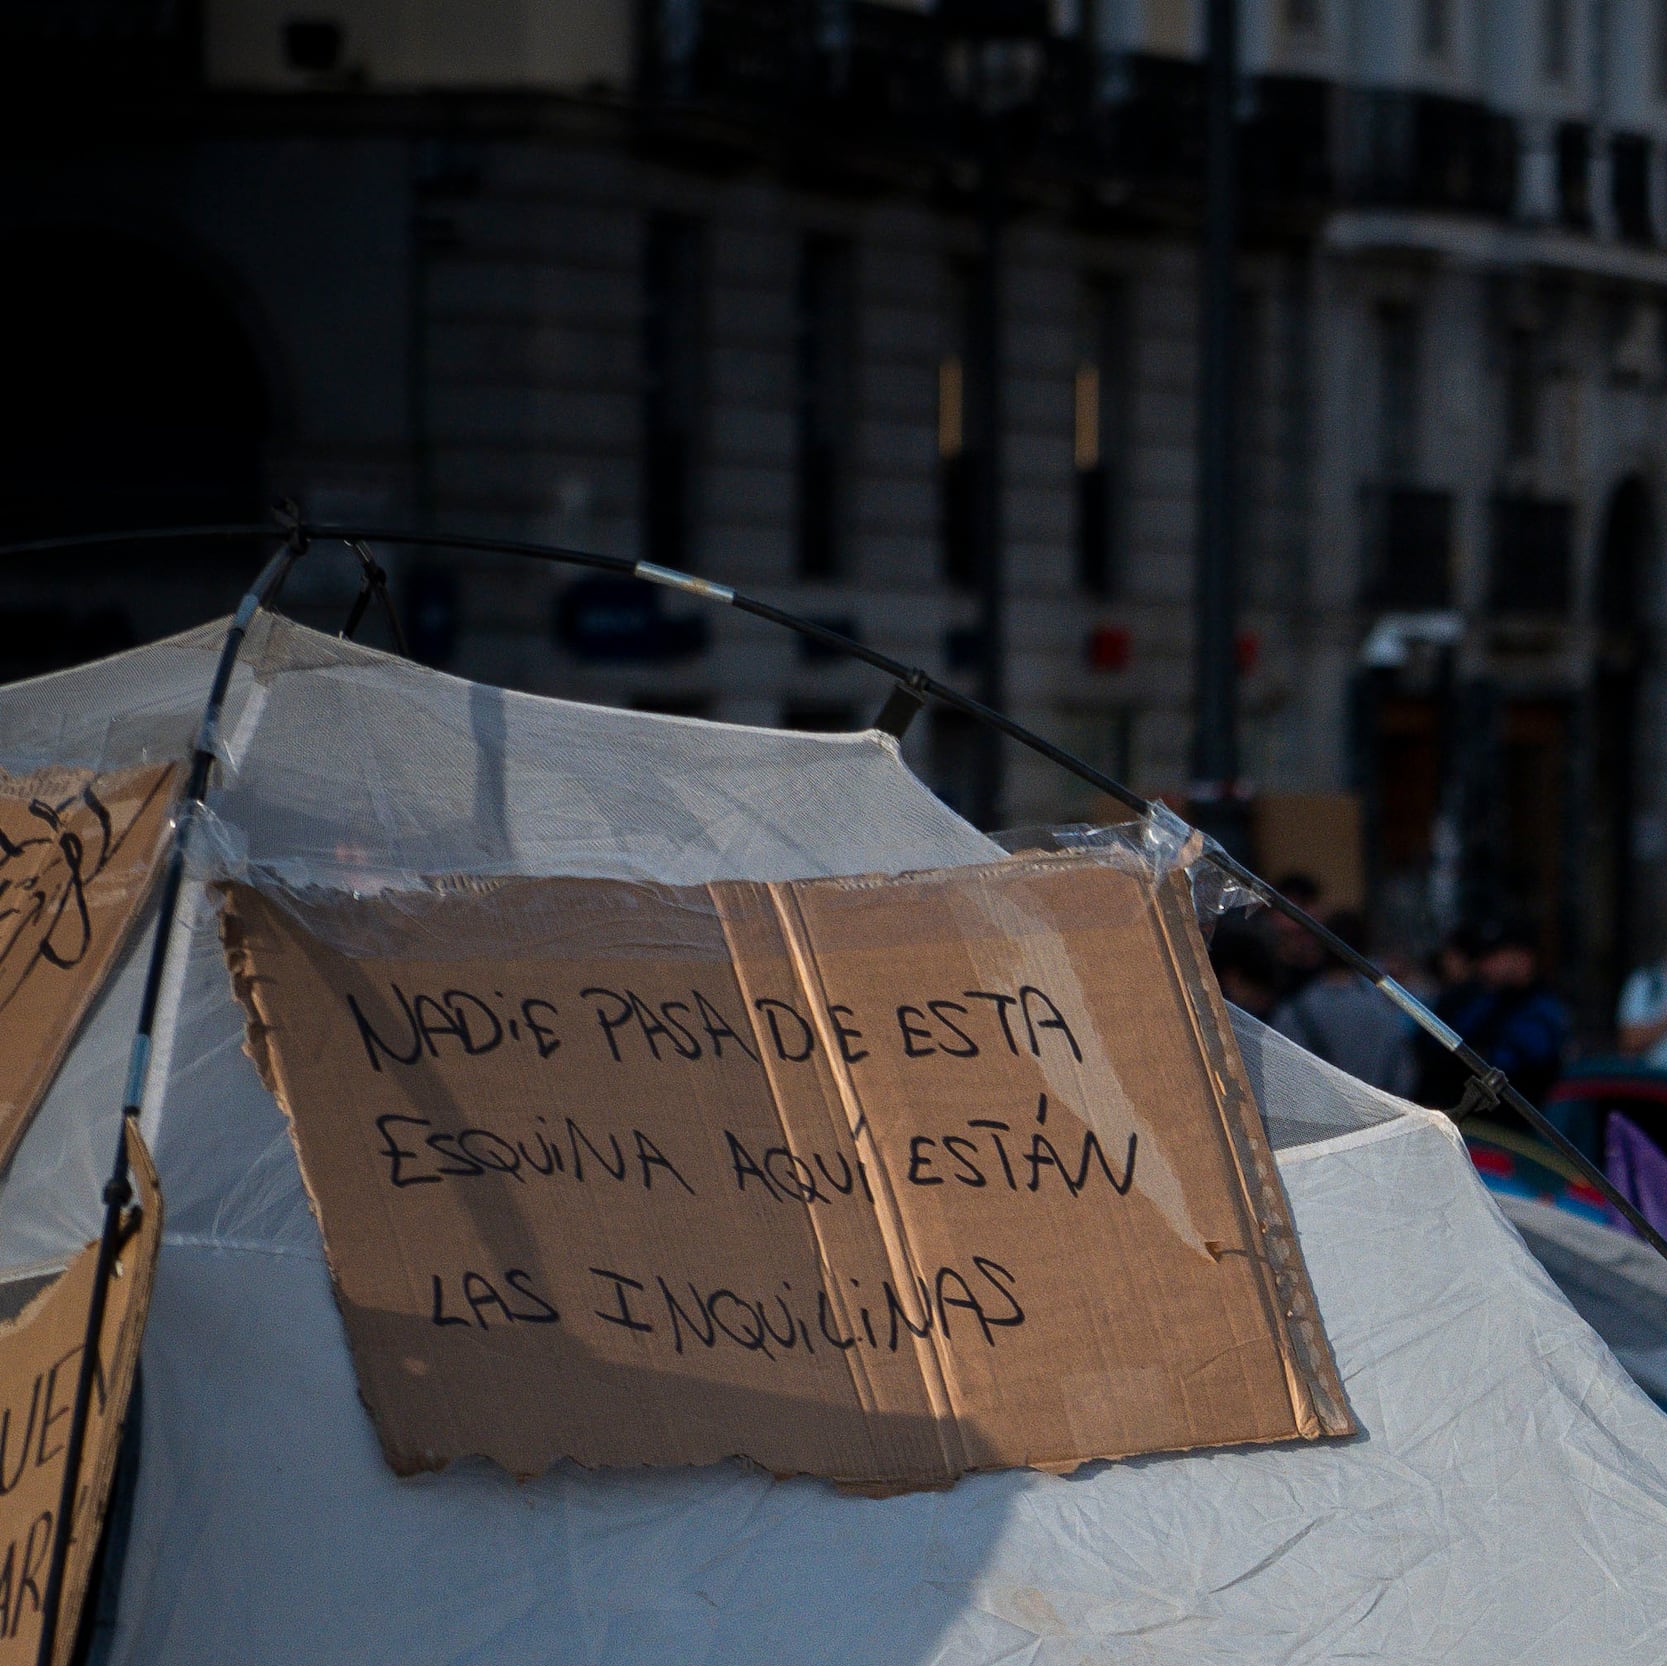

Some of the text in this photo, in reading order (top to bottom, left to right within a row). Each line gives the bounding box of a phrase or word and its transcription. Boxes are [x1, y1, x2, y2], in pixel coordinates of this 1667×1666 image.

[580, 987, 760, 1063] PASA
[757, 996, 868, 1063] DE
[899, 985, 1084, 1061] ESTA
[909, 1093, 1138, 1198] ESTÁN
[432, 1268, 562, 1332] LAS
